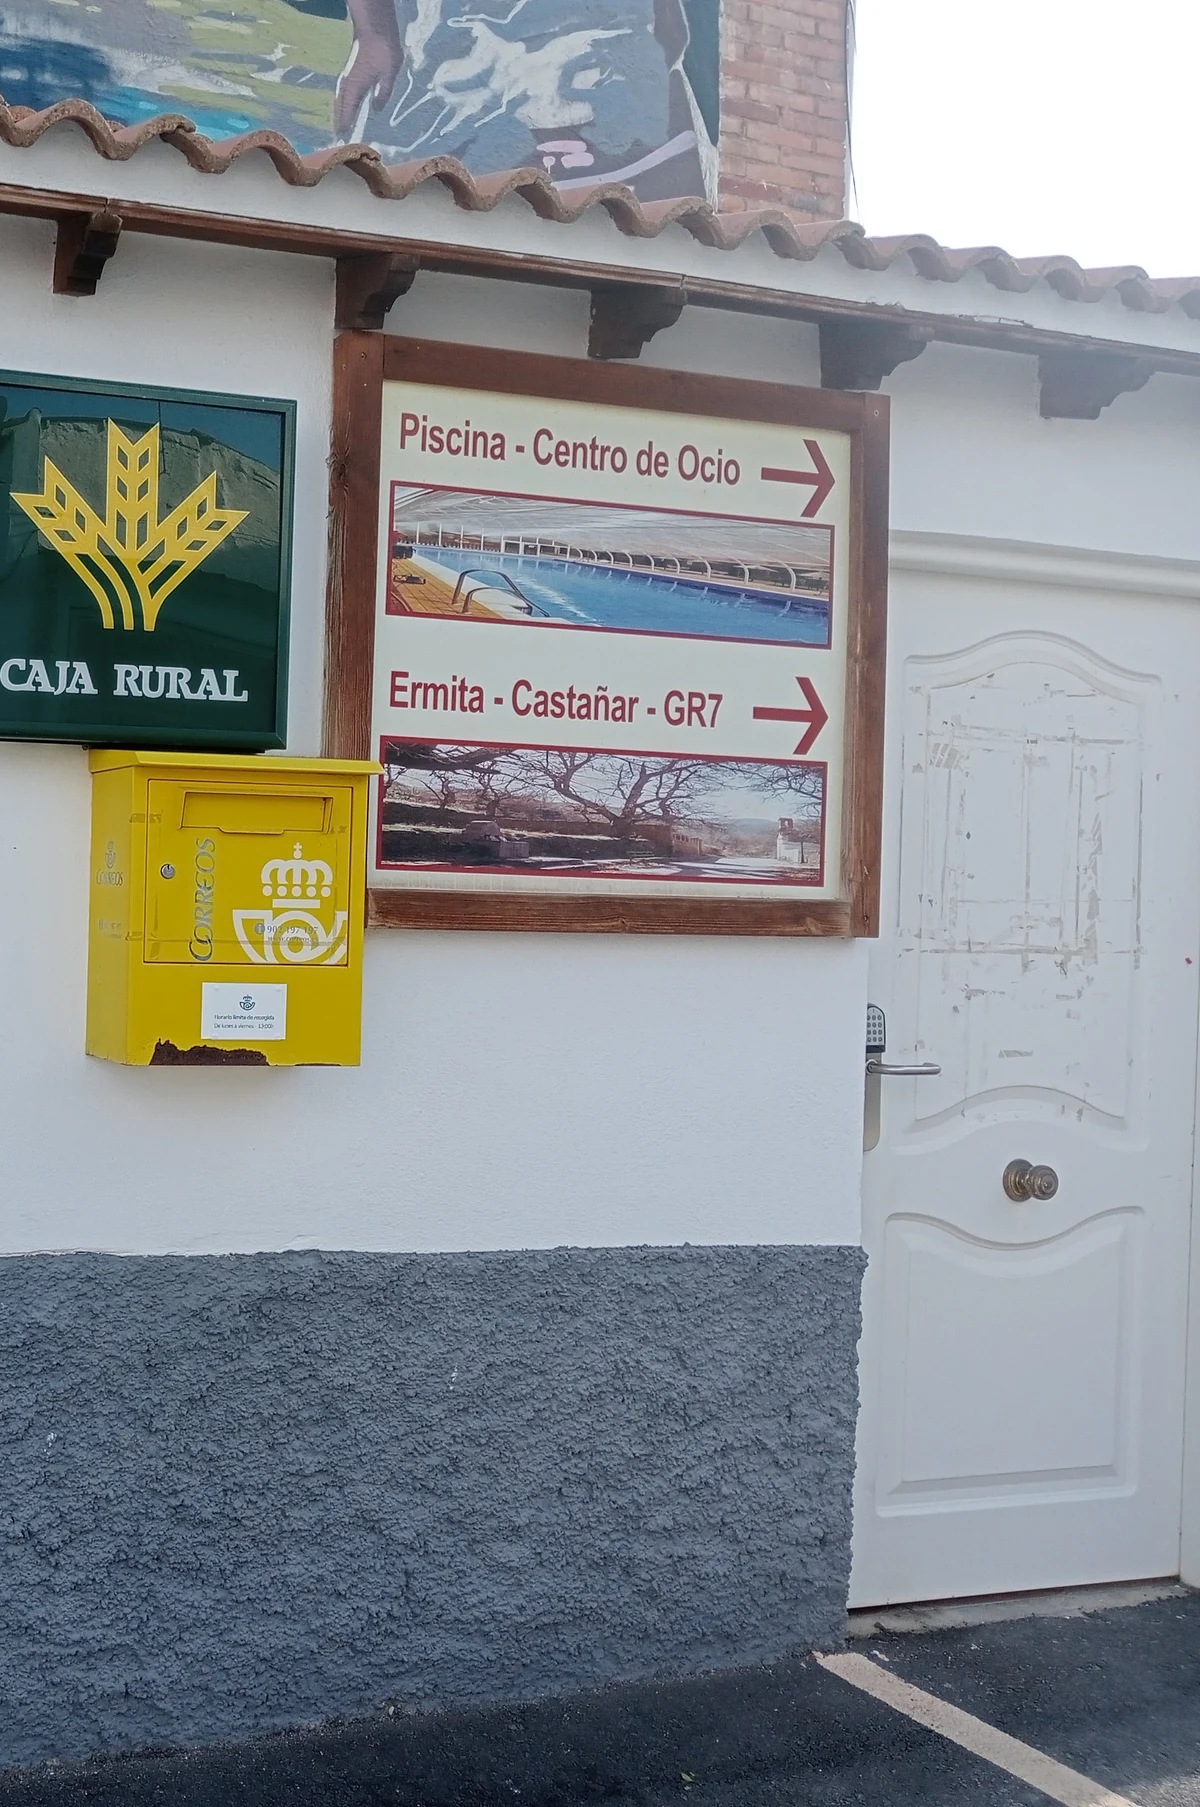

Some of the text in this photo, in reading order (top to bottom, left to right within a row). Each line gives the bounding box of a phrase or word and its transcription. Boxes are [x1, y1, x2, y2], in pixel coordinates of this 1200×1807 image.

[399, 412, 741, 486] Piscina - Centro de Ocio
[0, 658, 249, 702] CAJA RURAL
[389, 670, 724, 729] Ermita - Castañar - GR7
[189, 838, 216, 961] CORREOS
